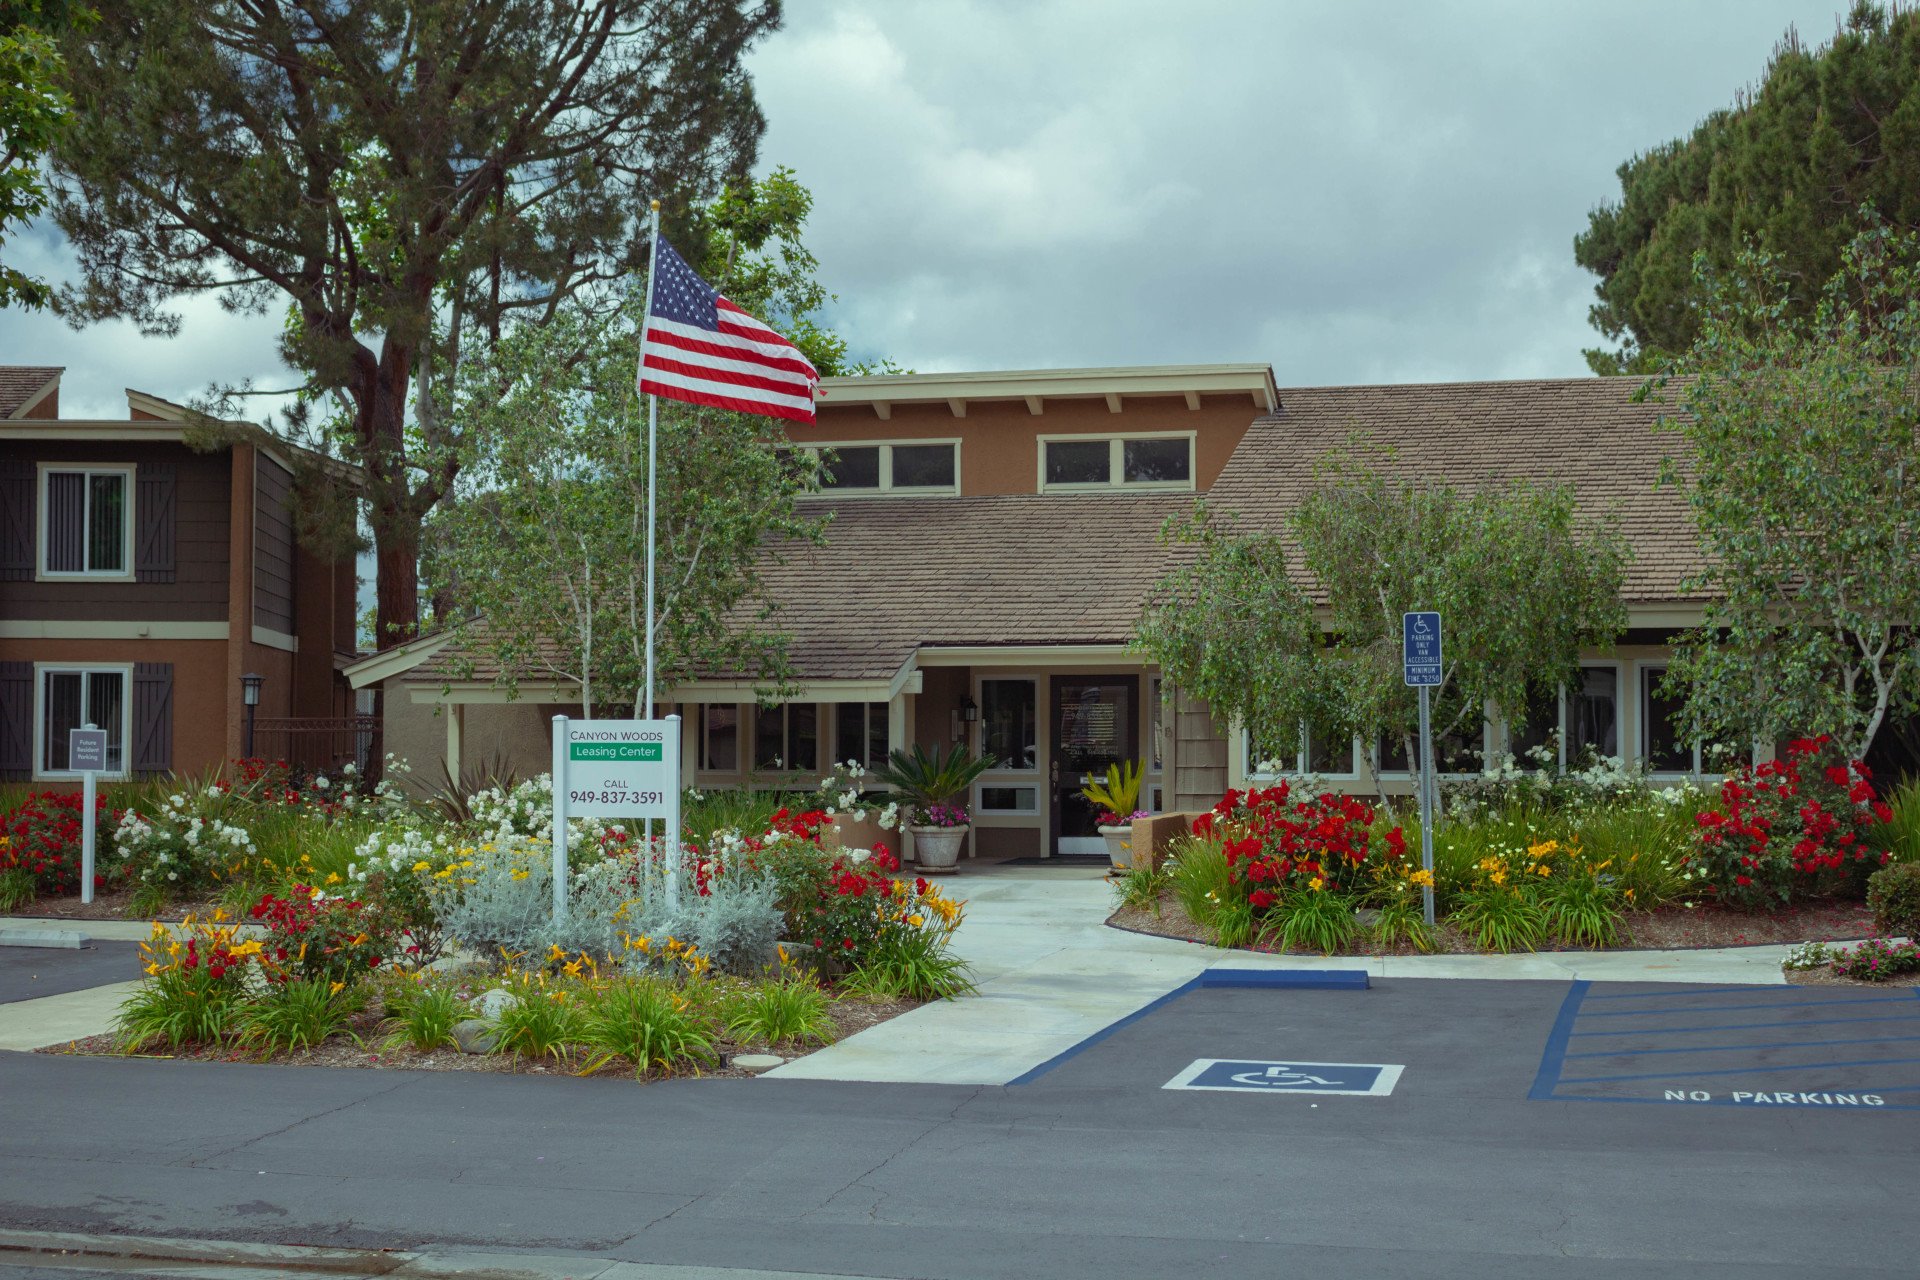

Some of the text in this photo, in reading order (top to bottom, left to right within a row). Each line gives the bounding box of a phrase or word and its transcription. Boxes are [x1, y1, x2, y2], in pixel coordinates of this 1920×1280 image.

[571, 731, 663, 741] CANYON WOODS
[576, 747, 656, 758] Leasing Center
[604, 780, 628, 789] CALL
[571, 791, 663, 804] 949-837-3591
[1664, 1090, 1885, 1106] NO PARKING
